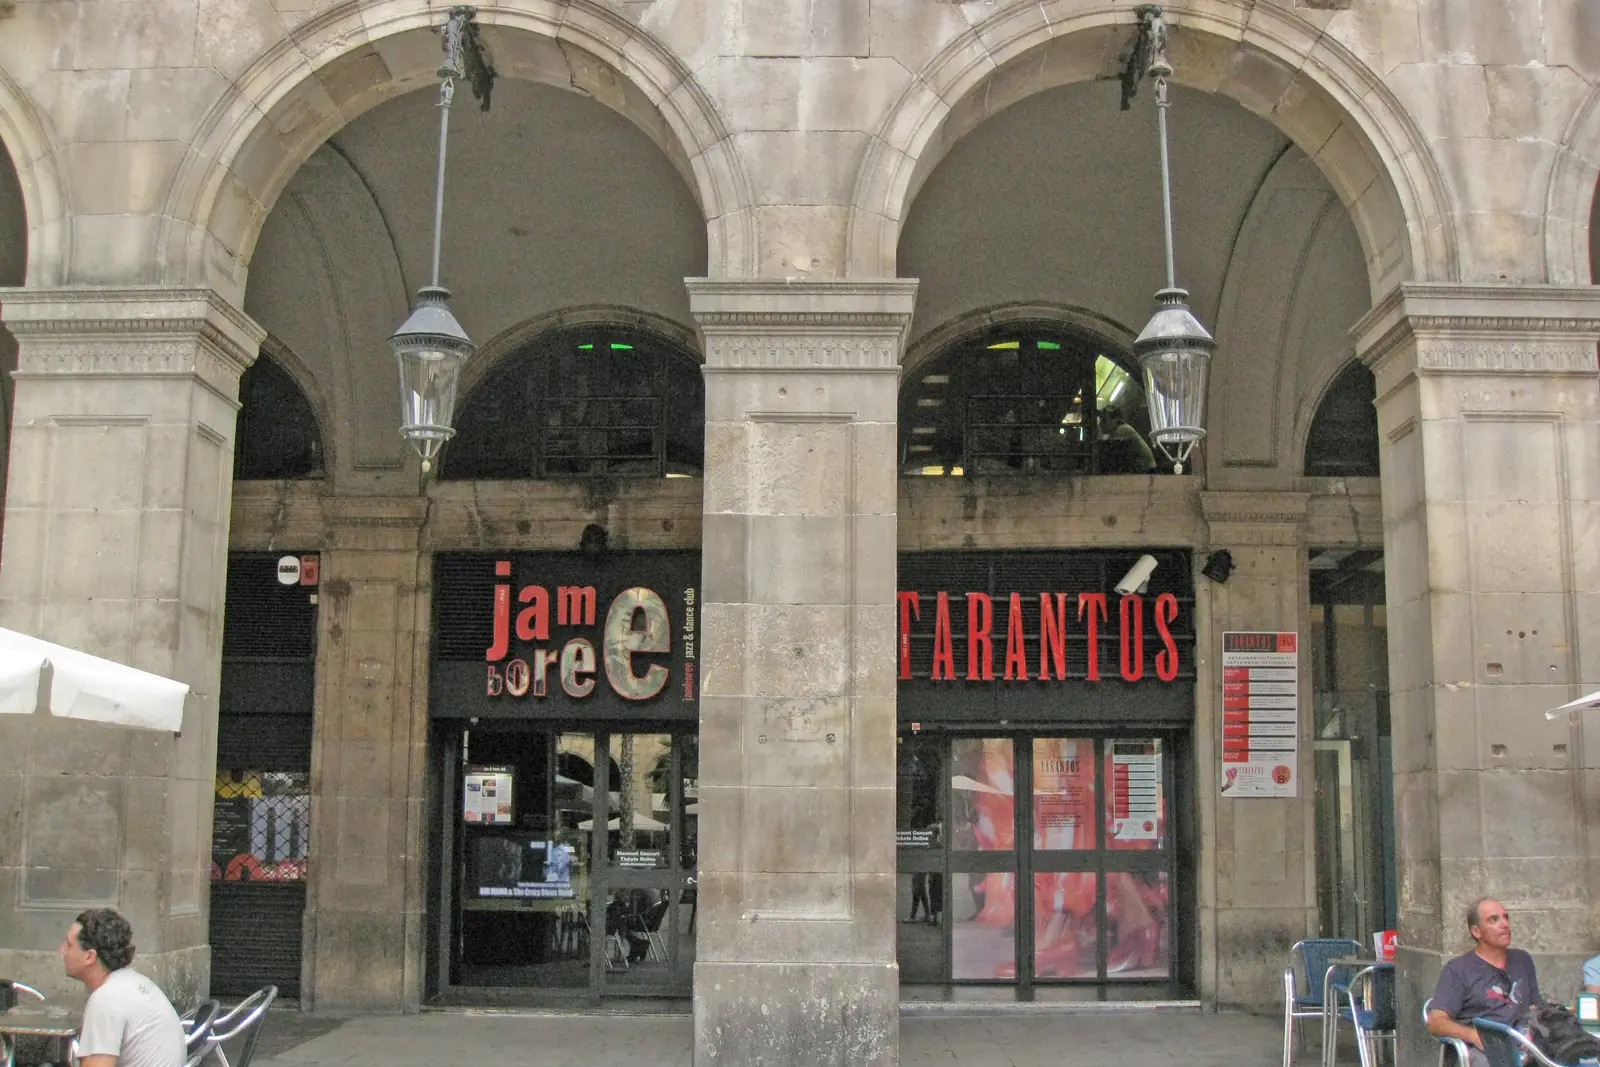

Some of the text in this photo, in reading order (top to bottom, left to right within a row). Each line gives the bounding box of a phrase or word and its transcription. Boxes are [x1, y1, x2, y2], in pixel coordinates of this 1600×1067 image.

[682, 587, 695, 701] jamboree jazz & dance club
[897, 592, 1179, 682] TARANTOS
[1228, 635, 1273, 649] TARANTOS
[1040, 760, 1080, 773] TARANTOS
